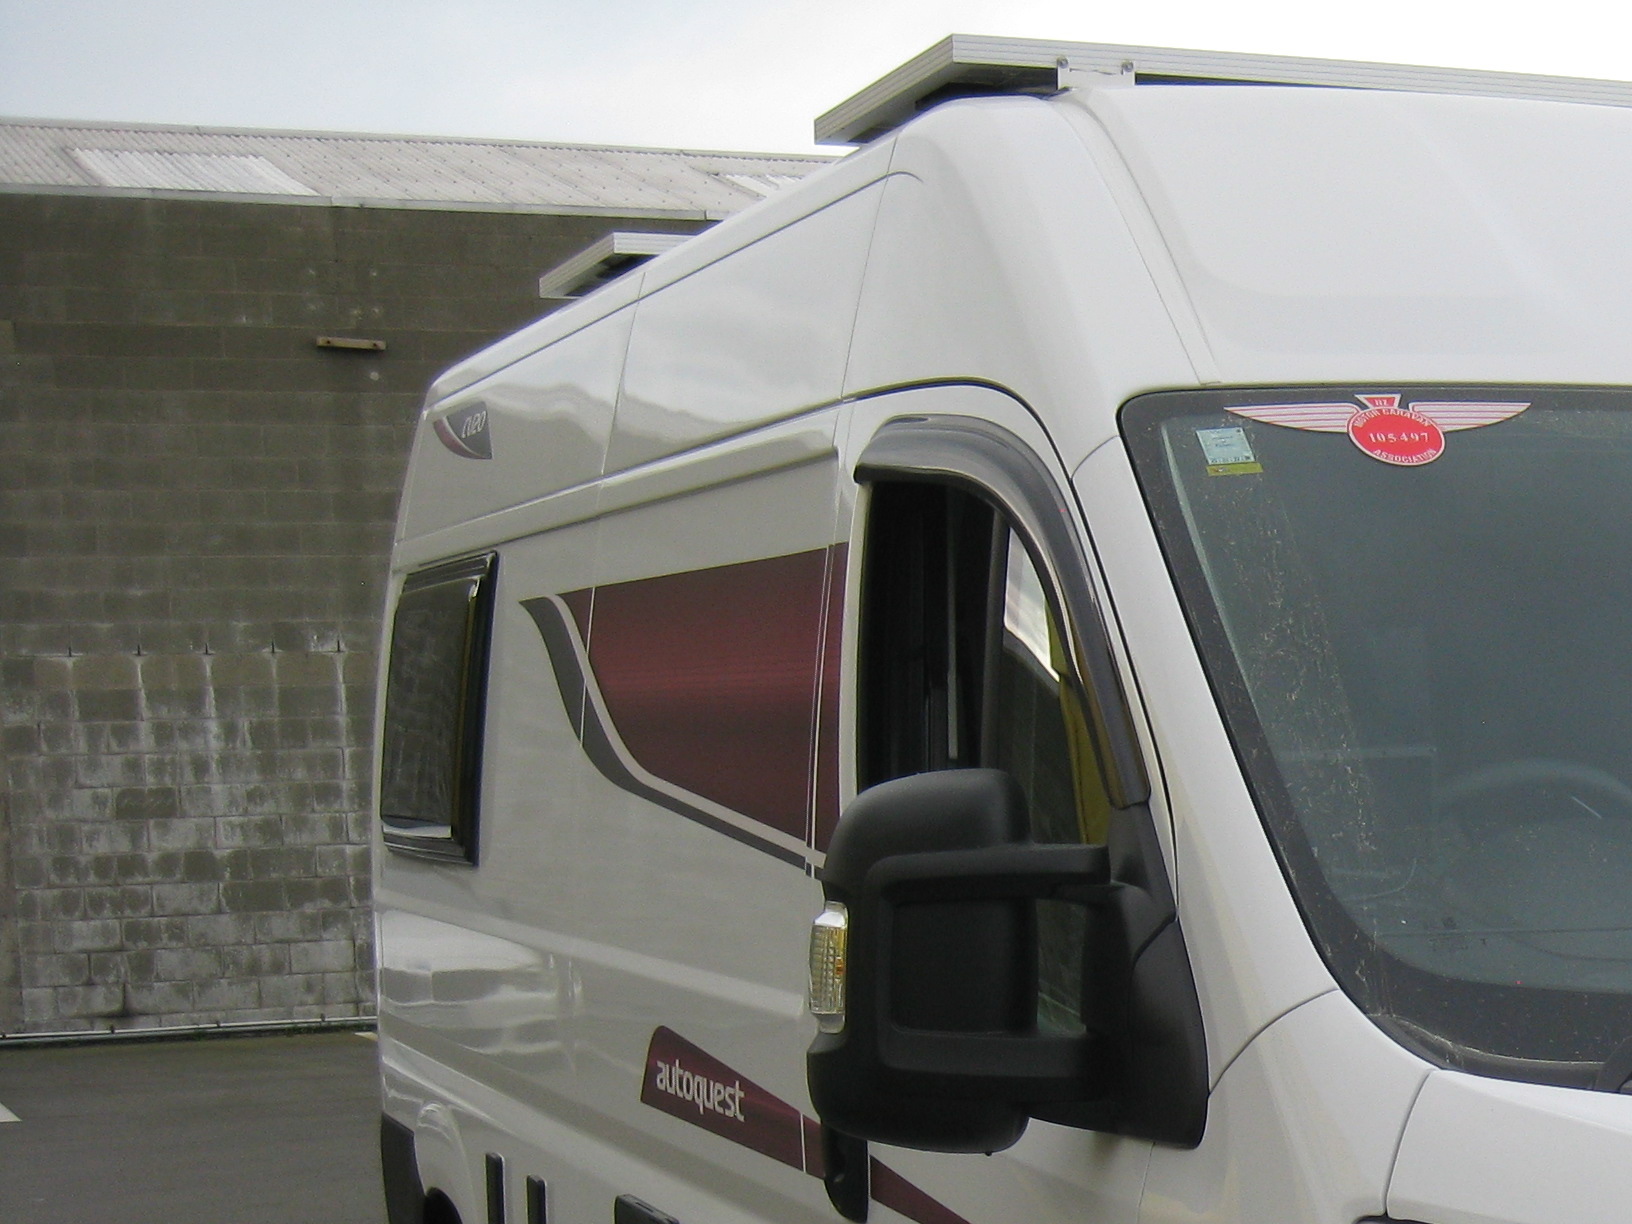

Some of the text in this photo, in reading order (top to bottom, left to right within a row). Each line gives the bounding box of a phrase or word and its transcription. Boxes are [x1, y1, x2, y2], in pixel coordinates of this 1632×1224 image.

[1353, 408, 1433, 428] MOTOR CARAVAN
[1369, 432, 1430, 444] 105497
[1372, 447, 1437, 464] ASSOCIATION
[656, 1058, 745, 1122] autoquest
